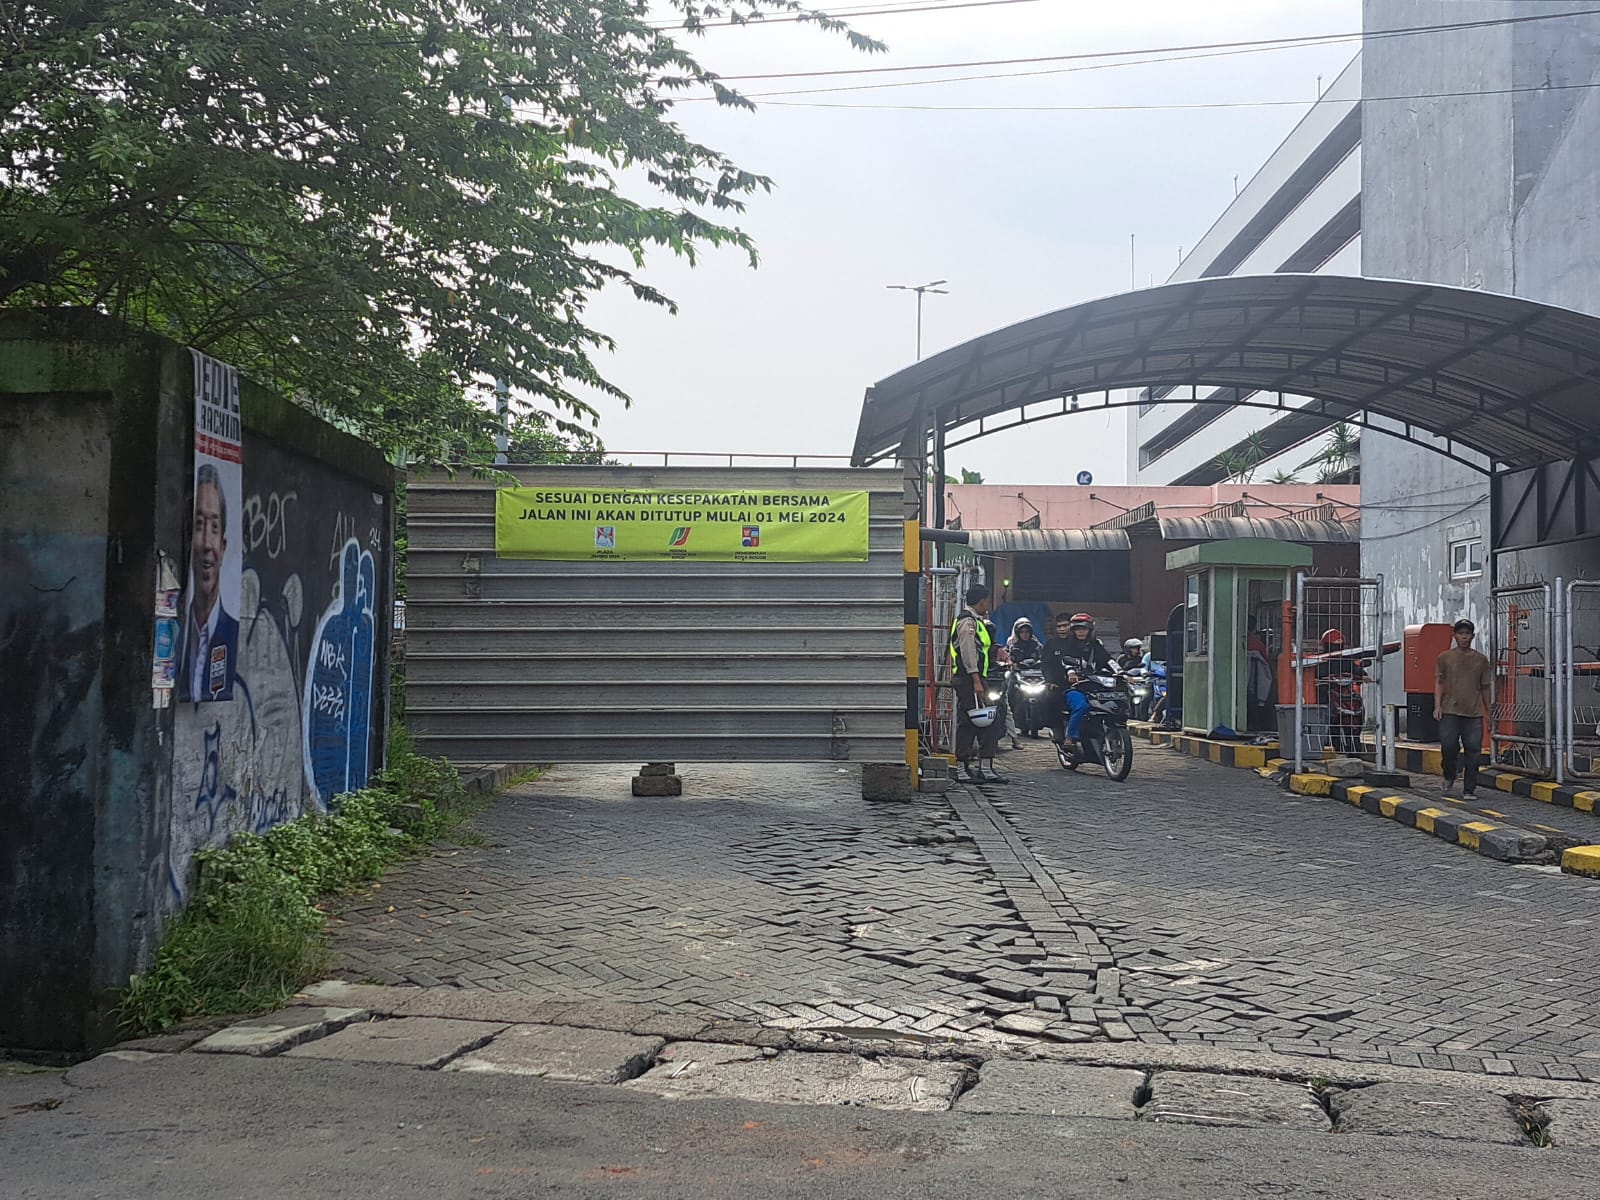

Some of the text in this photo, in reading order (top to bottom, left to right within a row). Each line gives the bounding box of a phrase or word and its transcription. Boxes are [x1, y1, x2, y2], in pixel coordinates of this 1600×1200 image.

[535, 492, 830, 507] SESUAI DENGAN KESEPAKATAN BERSAMA
[519, 509, 846, 523] JALAN INI AKAN DITUTUP MULAI 01 MEI 2024
